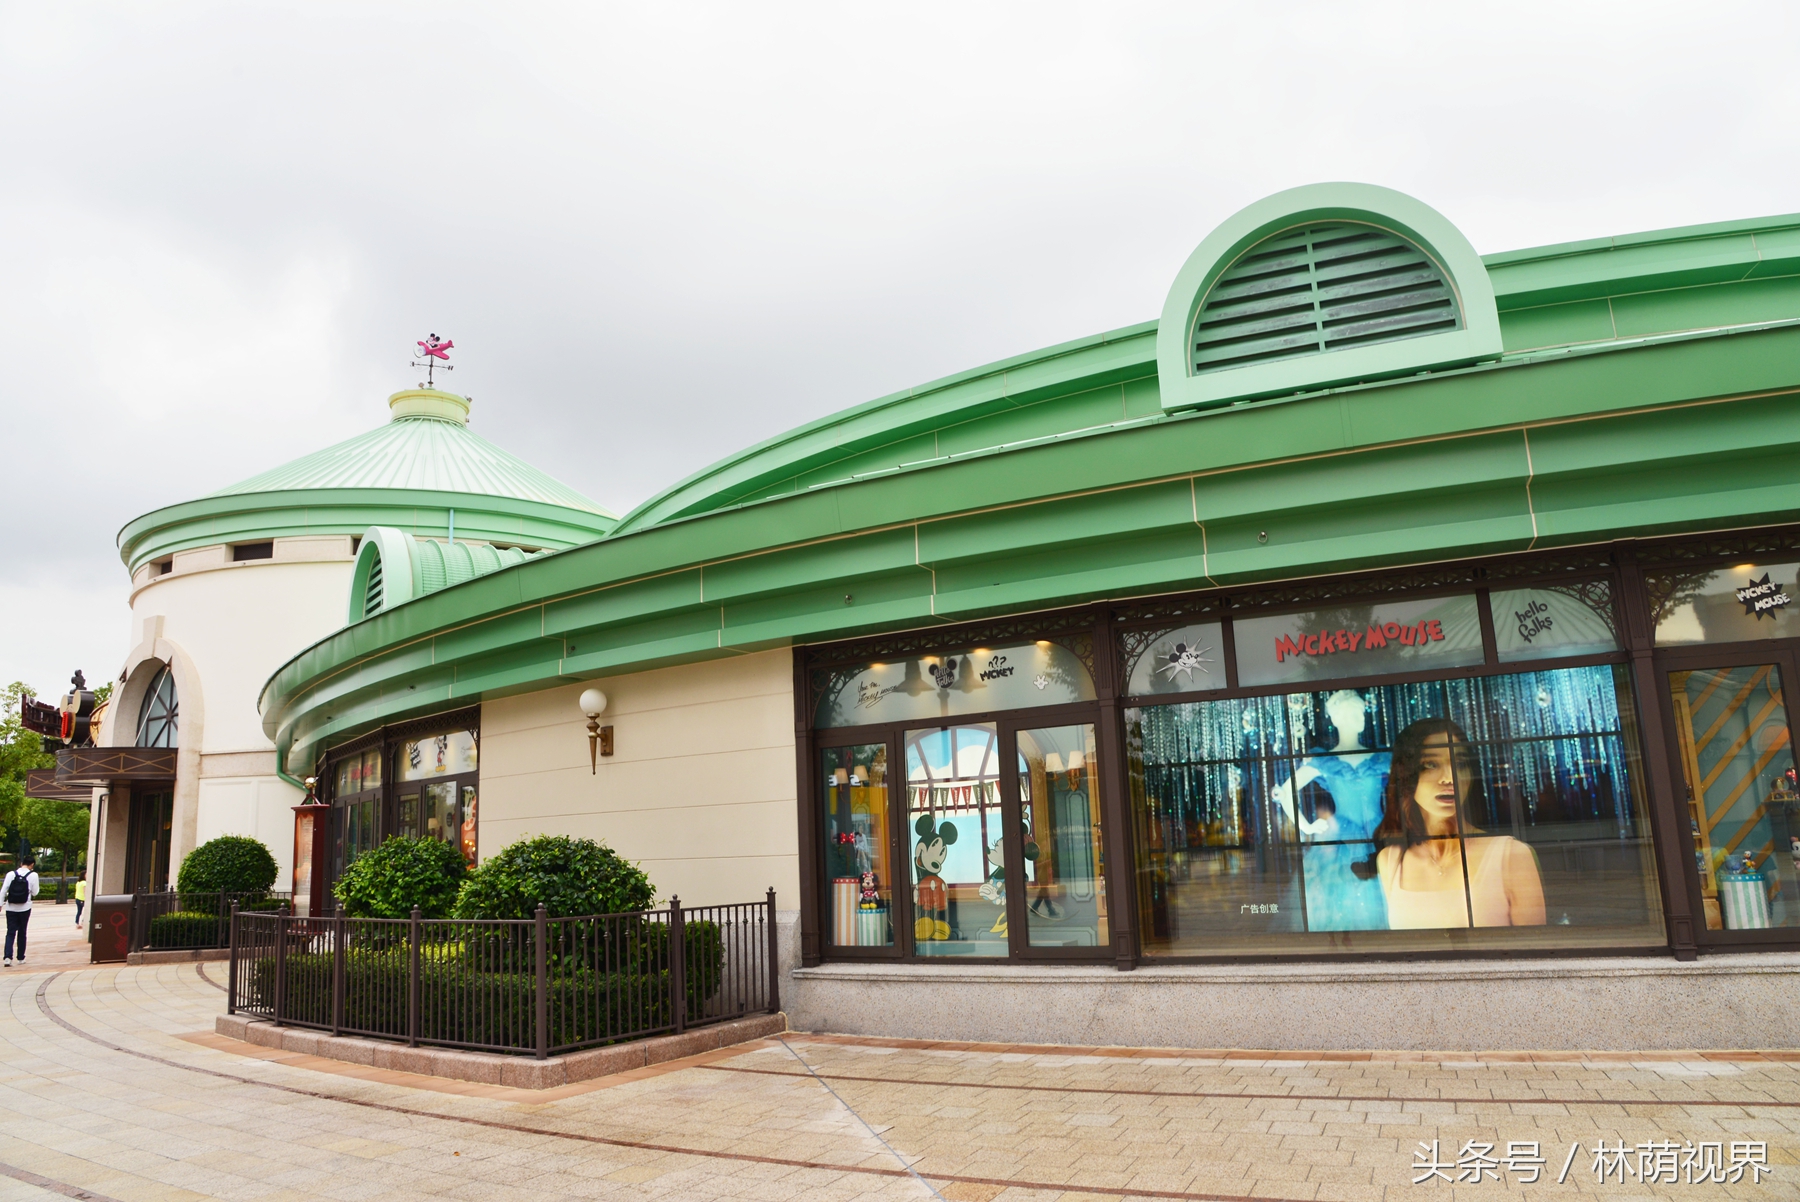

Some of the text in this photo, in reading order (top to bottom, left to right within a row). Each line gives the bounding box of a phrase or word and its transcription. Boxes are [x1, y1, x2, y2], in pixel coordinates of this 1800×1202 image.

[1735, 581, 1776, 602] MICKEY
[1754, 592, 1791, 611] MOUSE
[1515, 600, 1548, 624] hello
[1518, 616, 1553, 644] folks
[979, 666, 1015, 682] MICKEY
[1240, 903, 1279, 915] 广告创意
